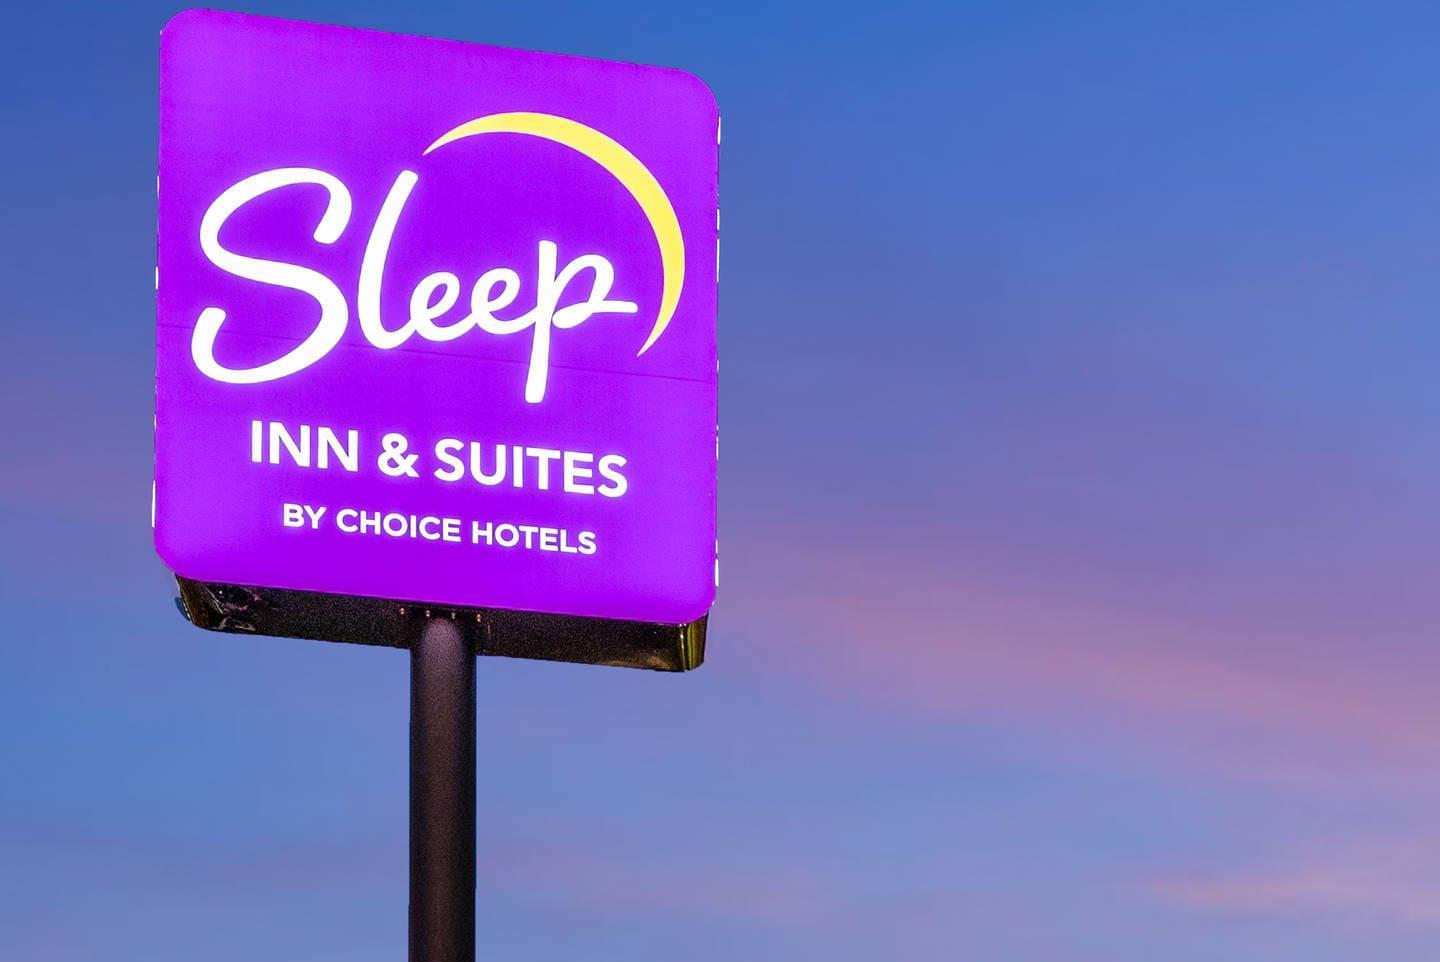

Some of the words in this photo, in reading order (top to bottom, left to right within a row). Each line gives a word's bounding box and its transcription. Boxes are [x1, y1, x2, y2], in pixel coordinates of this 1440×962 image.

[190, 167, 639, 404] Sleep
[250, 420, 360, 473] INN
[377, 432, 419, 478] &
[434, 438, 629, 499] SUITES
[282, 503, 328, 530] BY
[335, 508, 461, 543] CHOICE
[470, 521, 598, 556] HOTELS
